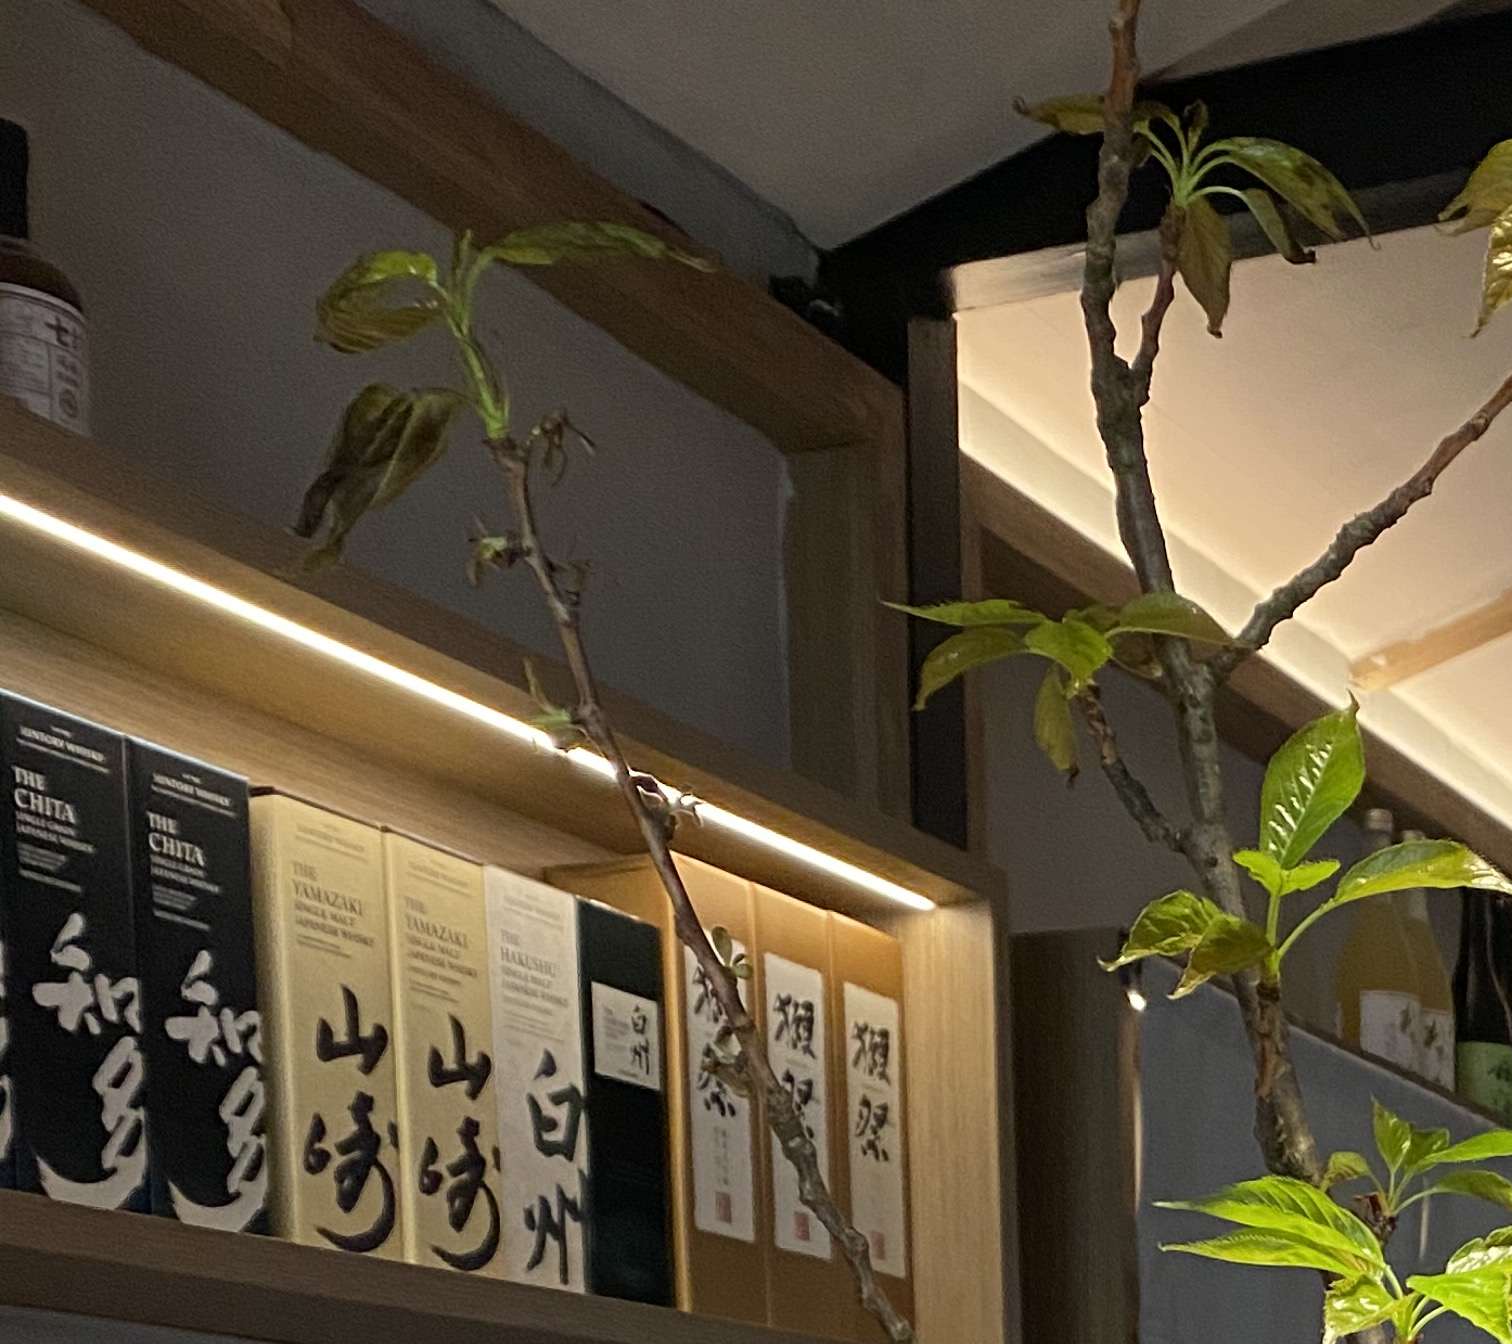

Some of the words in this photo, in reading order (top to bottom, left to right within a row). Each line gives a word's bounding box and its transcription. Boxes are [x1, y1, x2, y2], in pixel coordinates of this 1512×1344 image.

[12, 765, 46, 791] THE
[14, 787, 76, 825] CHITA
[146, 810, 178, 836] THE
[148, 832, 206, 867] CHITA
[293, 879, 363, 917] YAMAZAKI
[404, 913, 469, 949] YAMAZAKI
[500, 947, 558, 978] HAKUSHU
[629, 1004, 651, 1075] 白州
[522, 1048, 588, 1286] 白州
